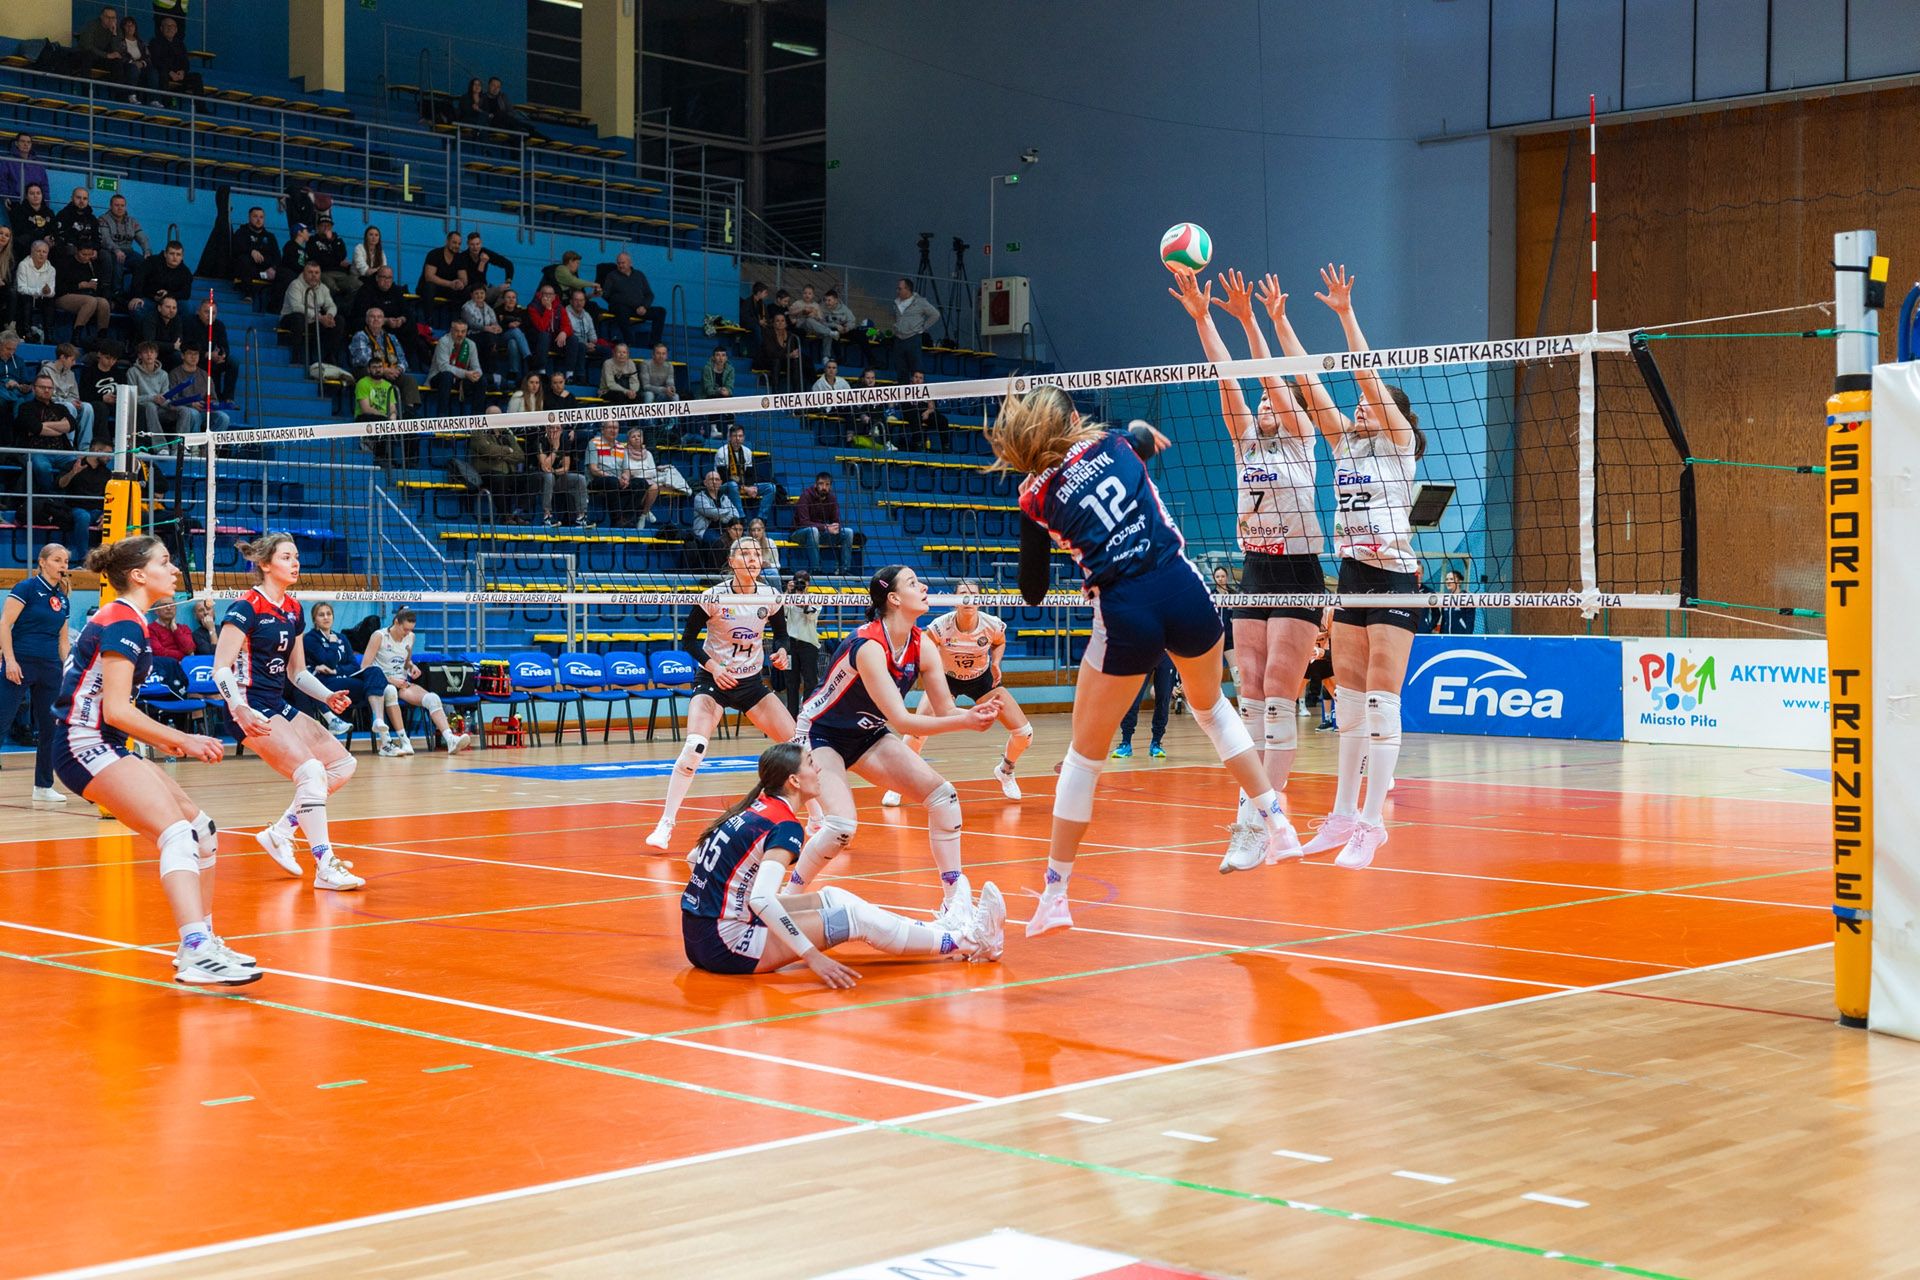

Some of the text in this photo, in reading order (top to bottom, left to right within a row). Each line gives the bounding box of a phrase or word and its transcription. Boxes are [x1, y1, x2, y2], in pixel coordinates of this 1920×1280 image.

[1341, 338, 1574, 369] ENEA KLUB SIATKARSKI PIŁA
[1069, 372, 1102, 388] KLUB
[1105, 366, 1183, 385] SIATKARSKI
[1188, 363, 1219, 379] PIŁA
[774, 385, 931, 408] ENEA KLUB SIATKARSKI PIŁA
[559, 403, 690, 423] ENEA KLUB SIATKARSKI PIŁA
[375, 415, 489, 433] ENEA KLUB SIATKARSKI PIŁA
[217, 426, 315, 443] ENEA KLUB SIATKARSKI PIŁA
[1062, 459, 1089, 480] ENEA
[1056, 451, 1115, 505] ENERGETYK
[1243, 473, 1278, 483] Enea
[1338, 474, 1372, 486] Enea
[1079, 476, 1138, 532] 12
[1249, 491, 1265, 513] 7
[1339, 491, 1372, 512] 22
[1250, 522, 1289, 536] eneris
[1343, 521, 1380, 536] eneris
[342, 592, 358, 600] ENEA
[359, 592, 374, 600] KLUB
[375, 592, 408, 600] SIATKARSKI
[472, 593, 489, 602] ENEA
[491, 593, 508, 602] KLUB
[509, 593, 547, 602] SIATKARSKI
[619, 594, 720, 604] ENEA KLUB SIATKARSKI PIŁA
[784, 595, 871, 605] ENEA KLUB SIATKARS
[973, 596, 998, 606] ENEA
[1000, 596, 1023, 606] KLUB
[1220, 595, 1249, 606] KLUB
[1250, 595, 1314, 606] SIATKARSKI
[1319, 595, 1342, 607] PIŁA
[1443, 595, 1475, 607] ENEA
[1479, 595, 1511, 607] KLUB
[1597, 595, 1622, 607] IŁA
[277, 630, 289, 651] 5
[732, 631, 759, 640] Enea
[732, 642, 754, 658] 14
[520, 666, 552, 677] Enea
[570, 666, 602, 677] Enea
[615, 666, 646, 675] Enea
[662, 665, 692, 674] Enea
[1730, 665, 1827, 684] AKTYWNE
[1830, 443, 1862, 935] SPORT TRANSFER
[1428, 675, 1564, 719] Enea
[1640, 713, 1717, 728] Miasto Piła
